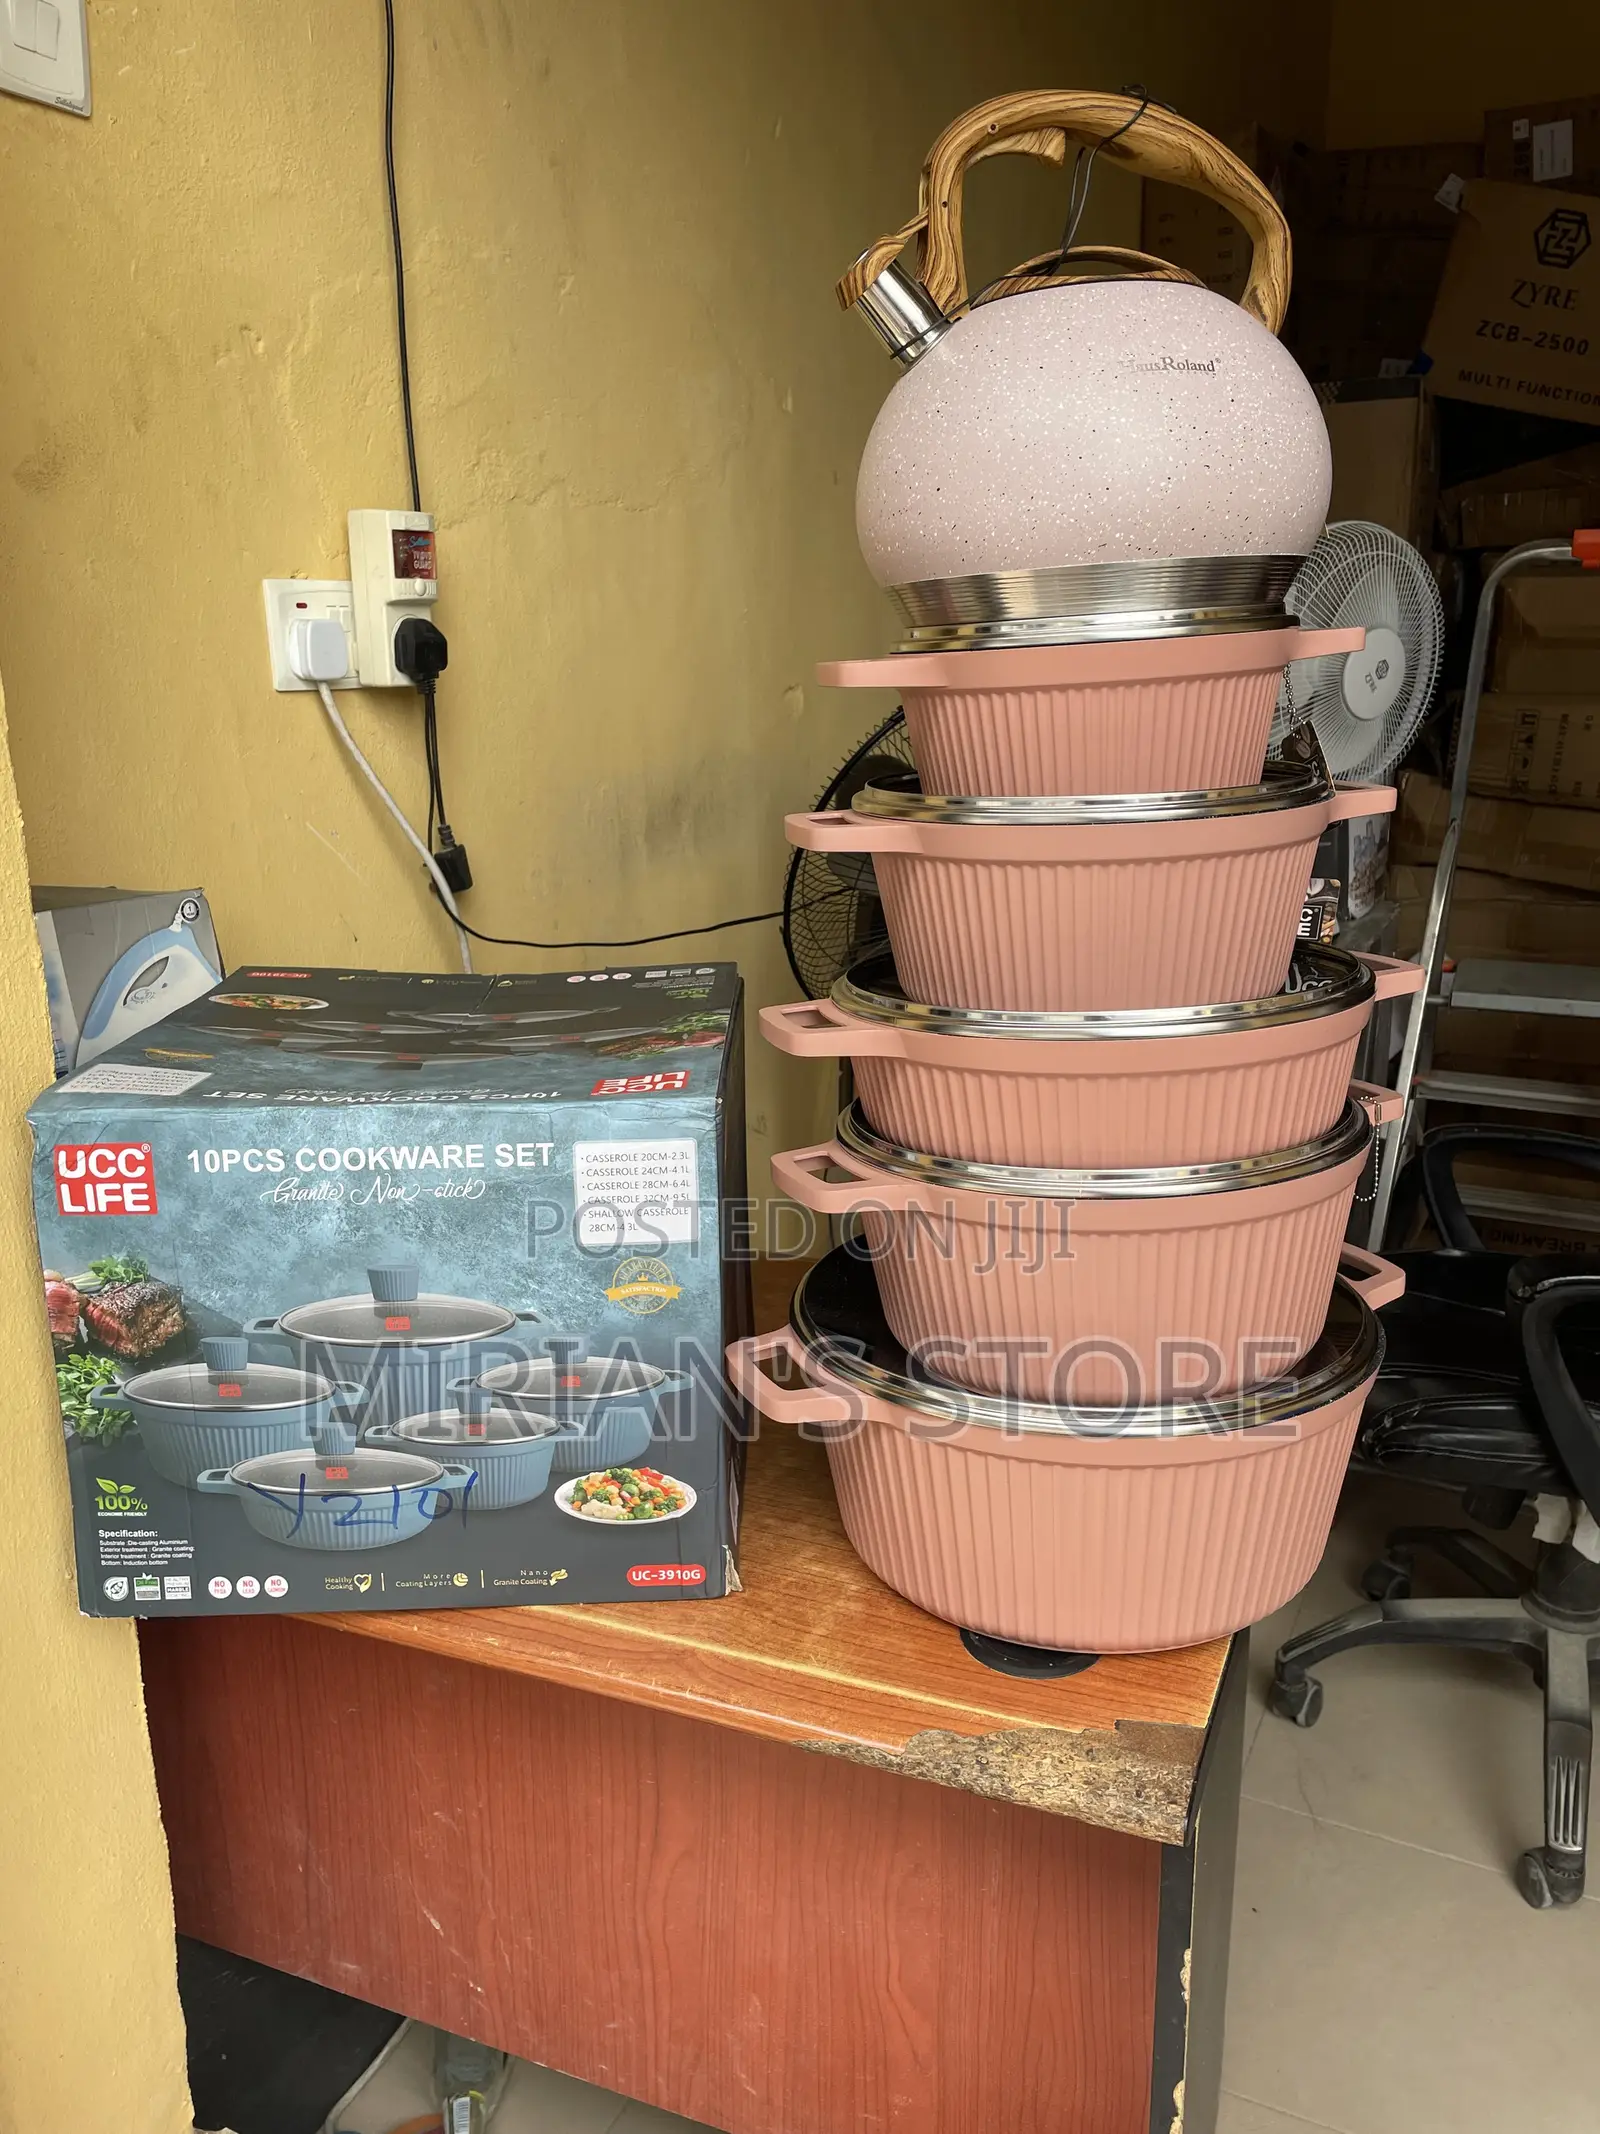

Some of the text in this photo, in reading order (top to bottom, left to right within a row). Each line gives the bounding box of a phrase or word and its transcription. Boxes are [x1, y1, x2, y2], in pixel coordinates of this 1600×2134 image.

[1510, 279, 1579, 311] ZYRE
[1475, 319, 1590, 356] ZCB-2500
[1458, 369, 1511, 390] MULTI
[58, 1148, 147, 1179] UCC
[187, 1142, 555, 1173] 10PCS COOKWARE SET
[585, 1151, 690, 1163] CASSEROLE 20CM-2.3L
[586, 1165, 690, 1177] CASSEROLE 24CM-4.1L
[259, 1176, 344, 1204] Granite
[587, 1180, 691, 1191] CASSEROLE 28CM-6.4L
[60, 1182, 151, 1213] LIFE
[587, 1195, 640, 1205] CASSEROLE
[588, 1207, 689, 1219] SHALLOW CASSEROLE
[620, 1285, 668, 1294] SATISFACTION
[94, 1495, 148, 1511] 100%
[98, 1529, 159, 1539] Specification:
[632, 1569, 701, 1581] UC-3910G
